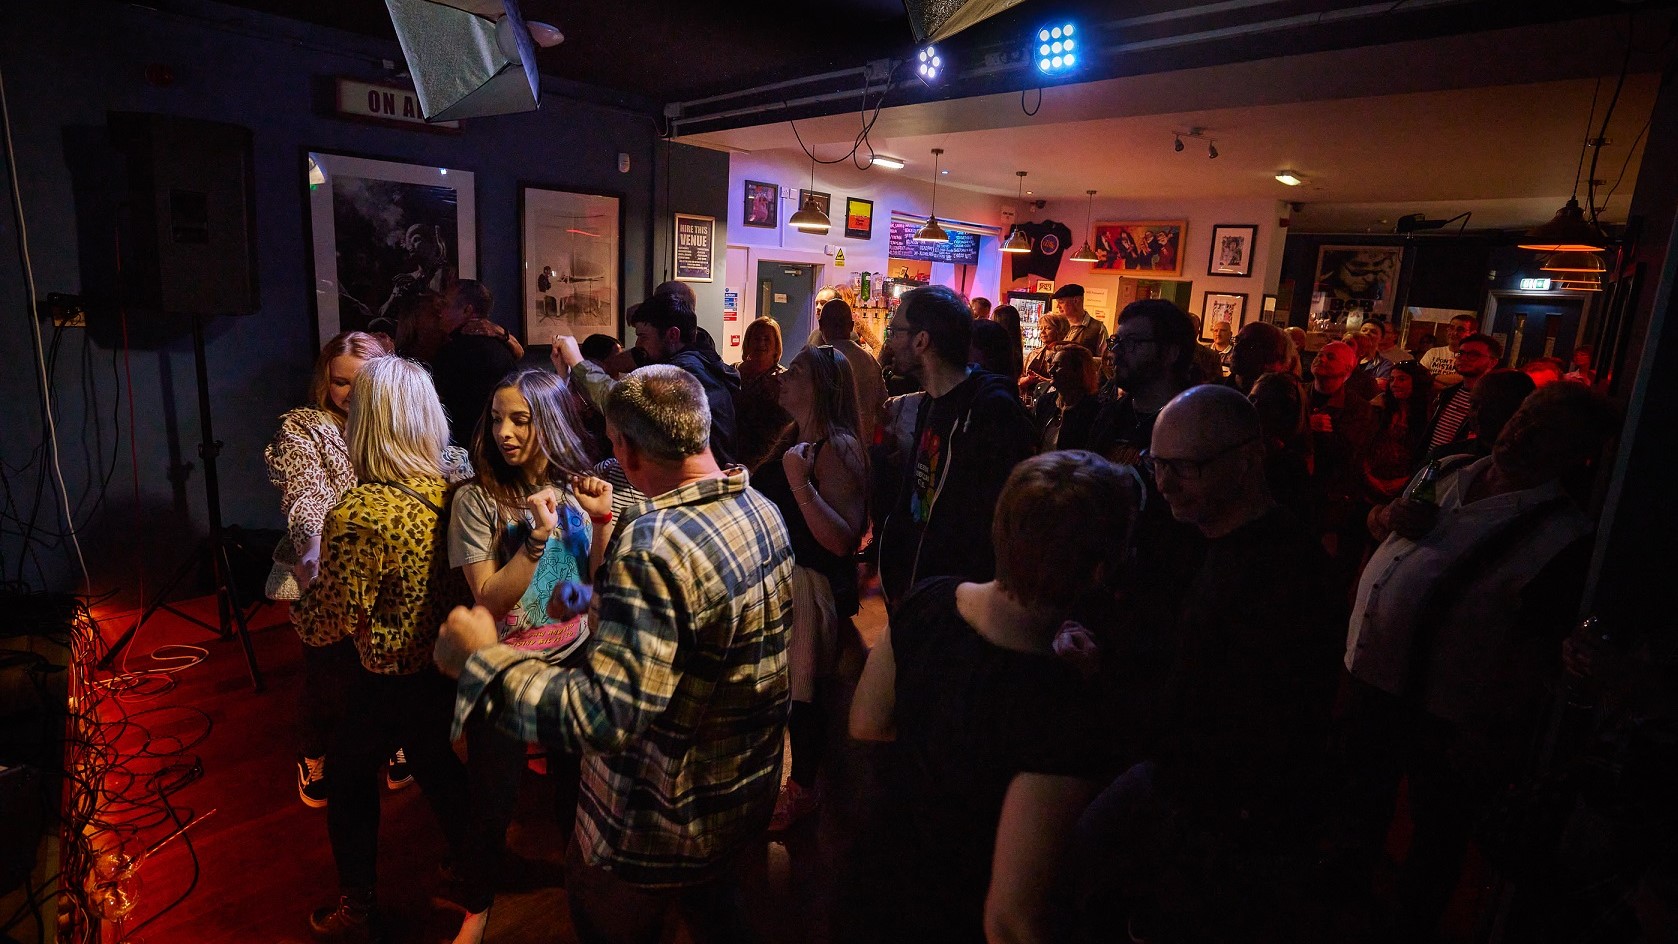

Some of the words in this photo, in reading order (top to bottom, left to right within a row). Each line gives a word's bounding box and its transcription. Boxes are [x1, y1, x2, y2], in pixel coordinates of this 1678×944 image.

[368, 90, 395, 115] ON
[680, 224, 694, 233] HIRE
[694, 225, 708, 235] THIS
[680, 233, 707, 247] VENUE
[1330, 298, 1374, 312] BOB
